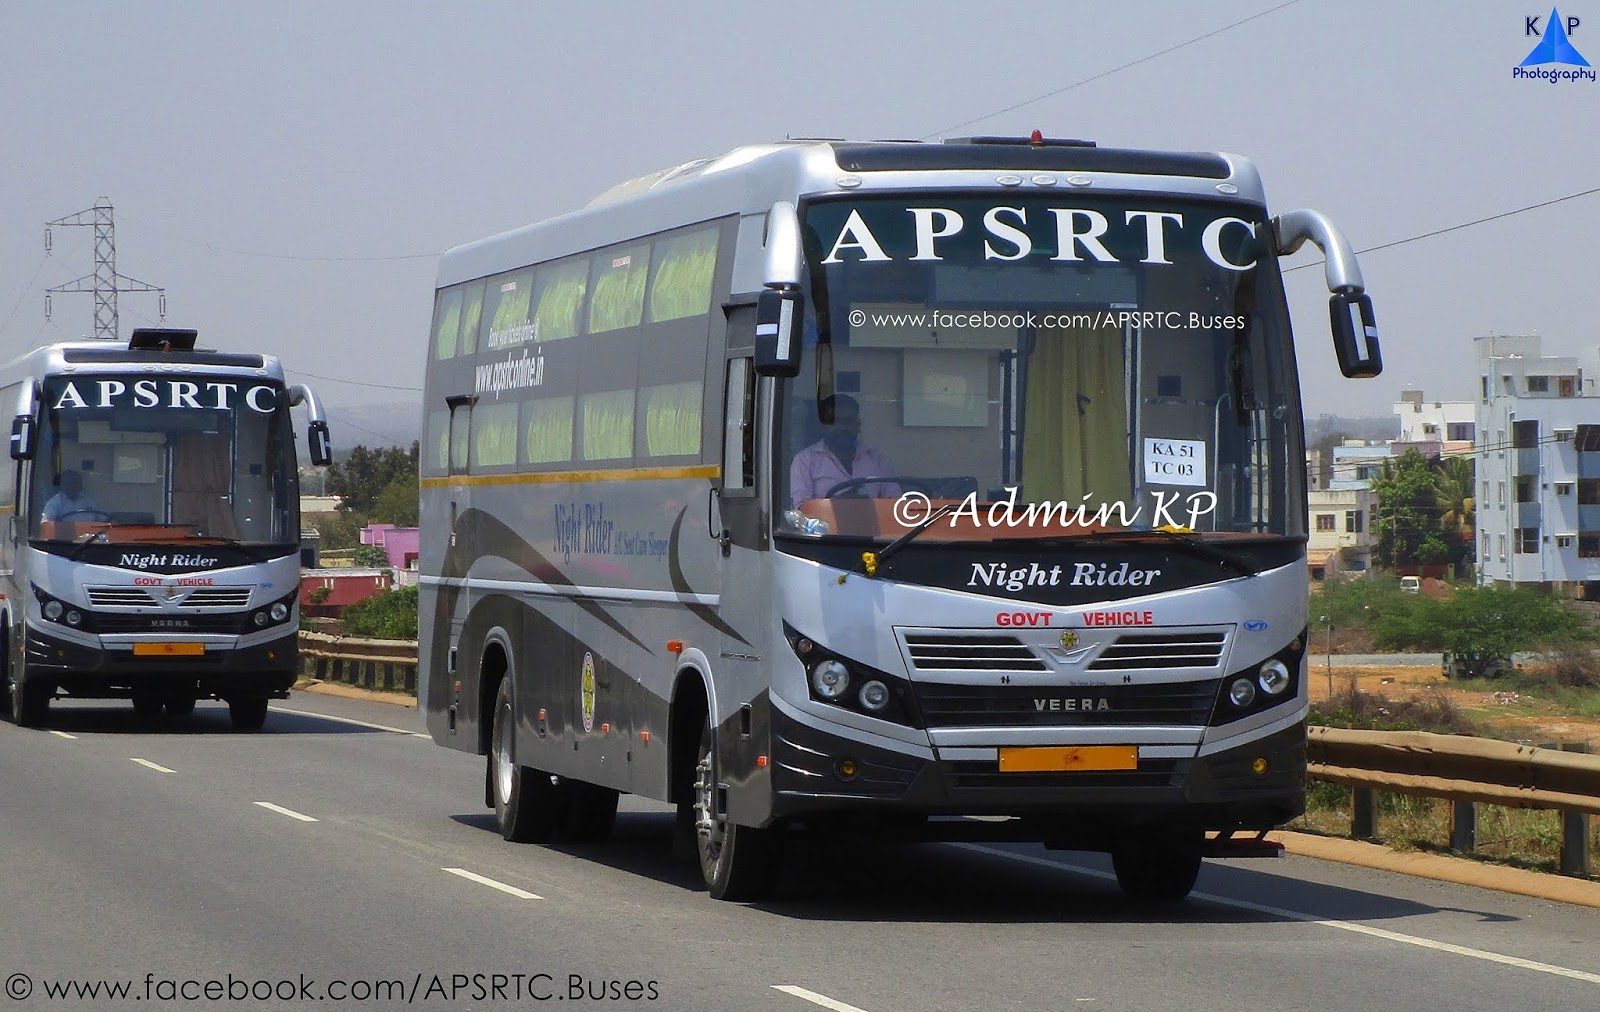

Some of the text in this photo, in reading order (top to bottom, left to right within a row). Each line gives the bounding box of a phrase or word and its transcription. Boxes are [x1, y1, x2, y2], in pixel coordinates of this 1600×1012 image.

[820, 205, 1258, 272] APSRTC
[53, 380, 277, 413] APSRTC
[1152, 442, 1194, 458] KA 51
[1152, 460, 1194, 476] TC 03
[553, 503, 581, 565] Night
[584, 503, 613, 554] Rider
[119, 553, 218, 569] Night Rider
[134, 578, 213, 586] GOVT VEHICLE
[966, 561, 1161, 592] Night Rider
[996, 611, 1154, 627] GOVT VEHICLE
[1033, 698, 1110, 711] VEERA
